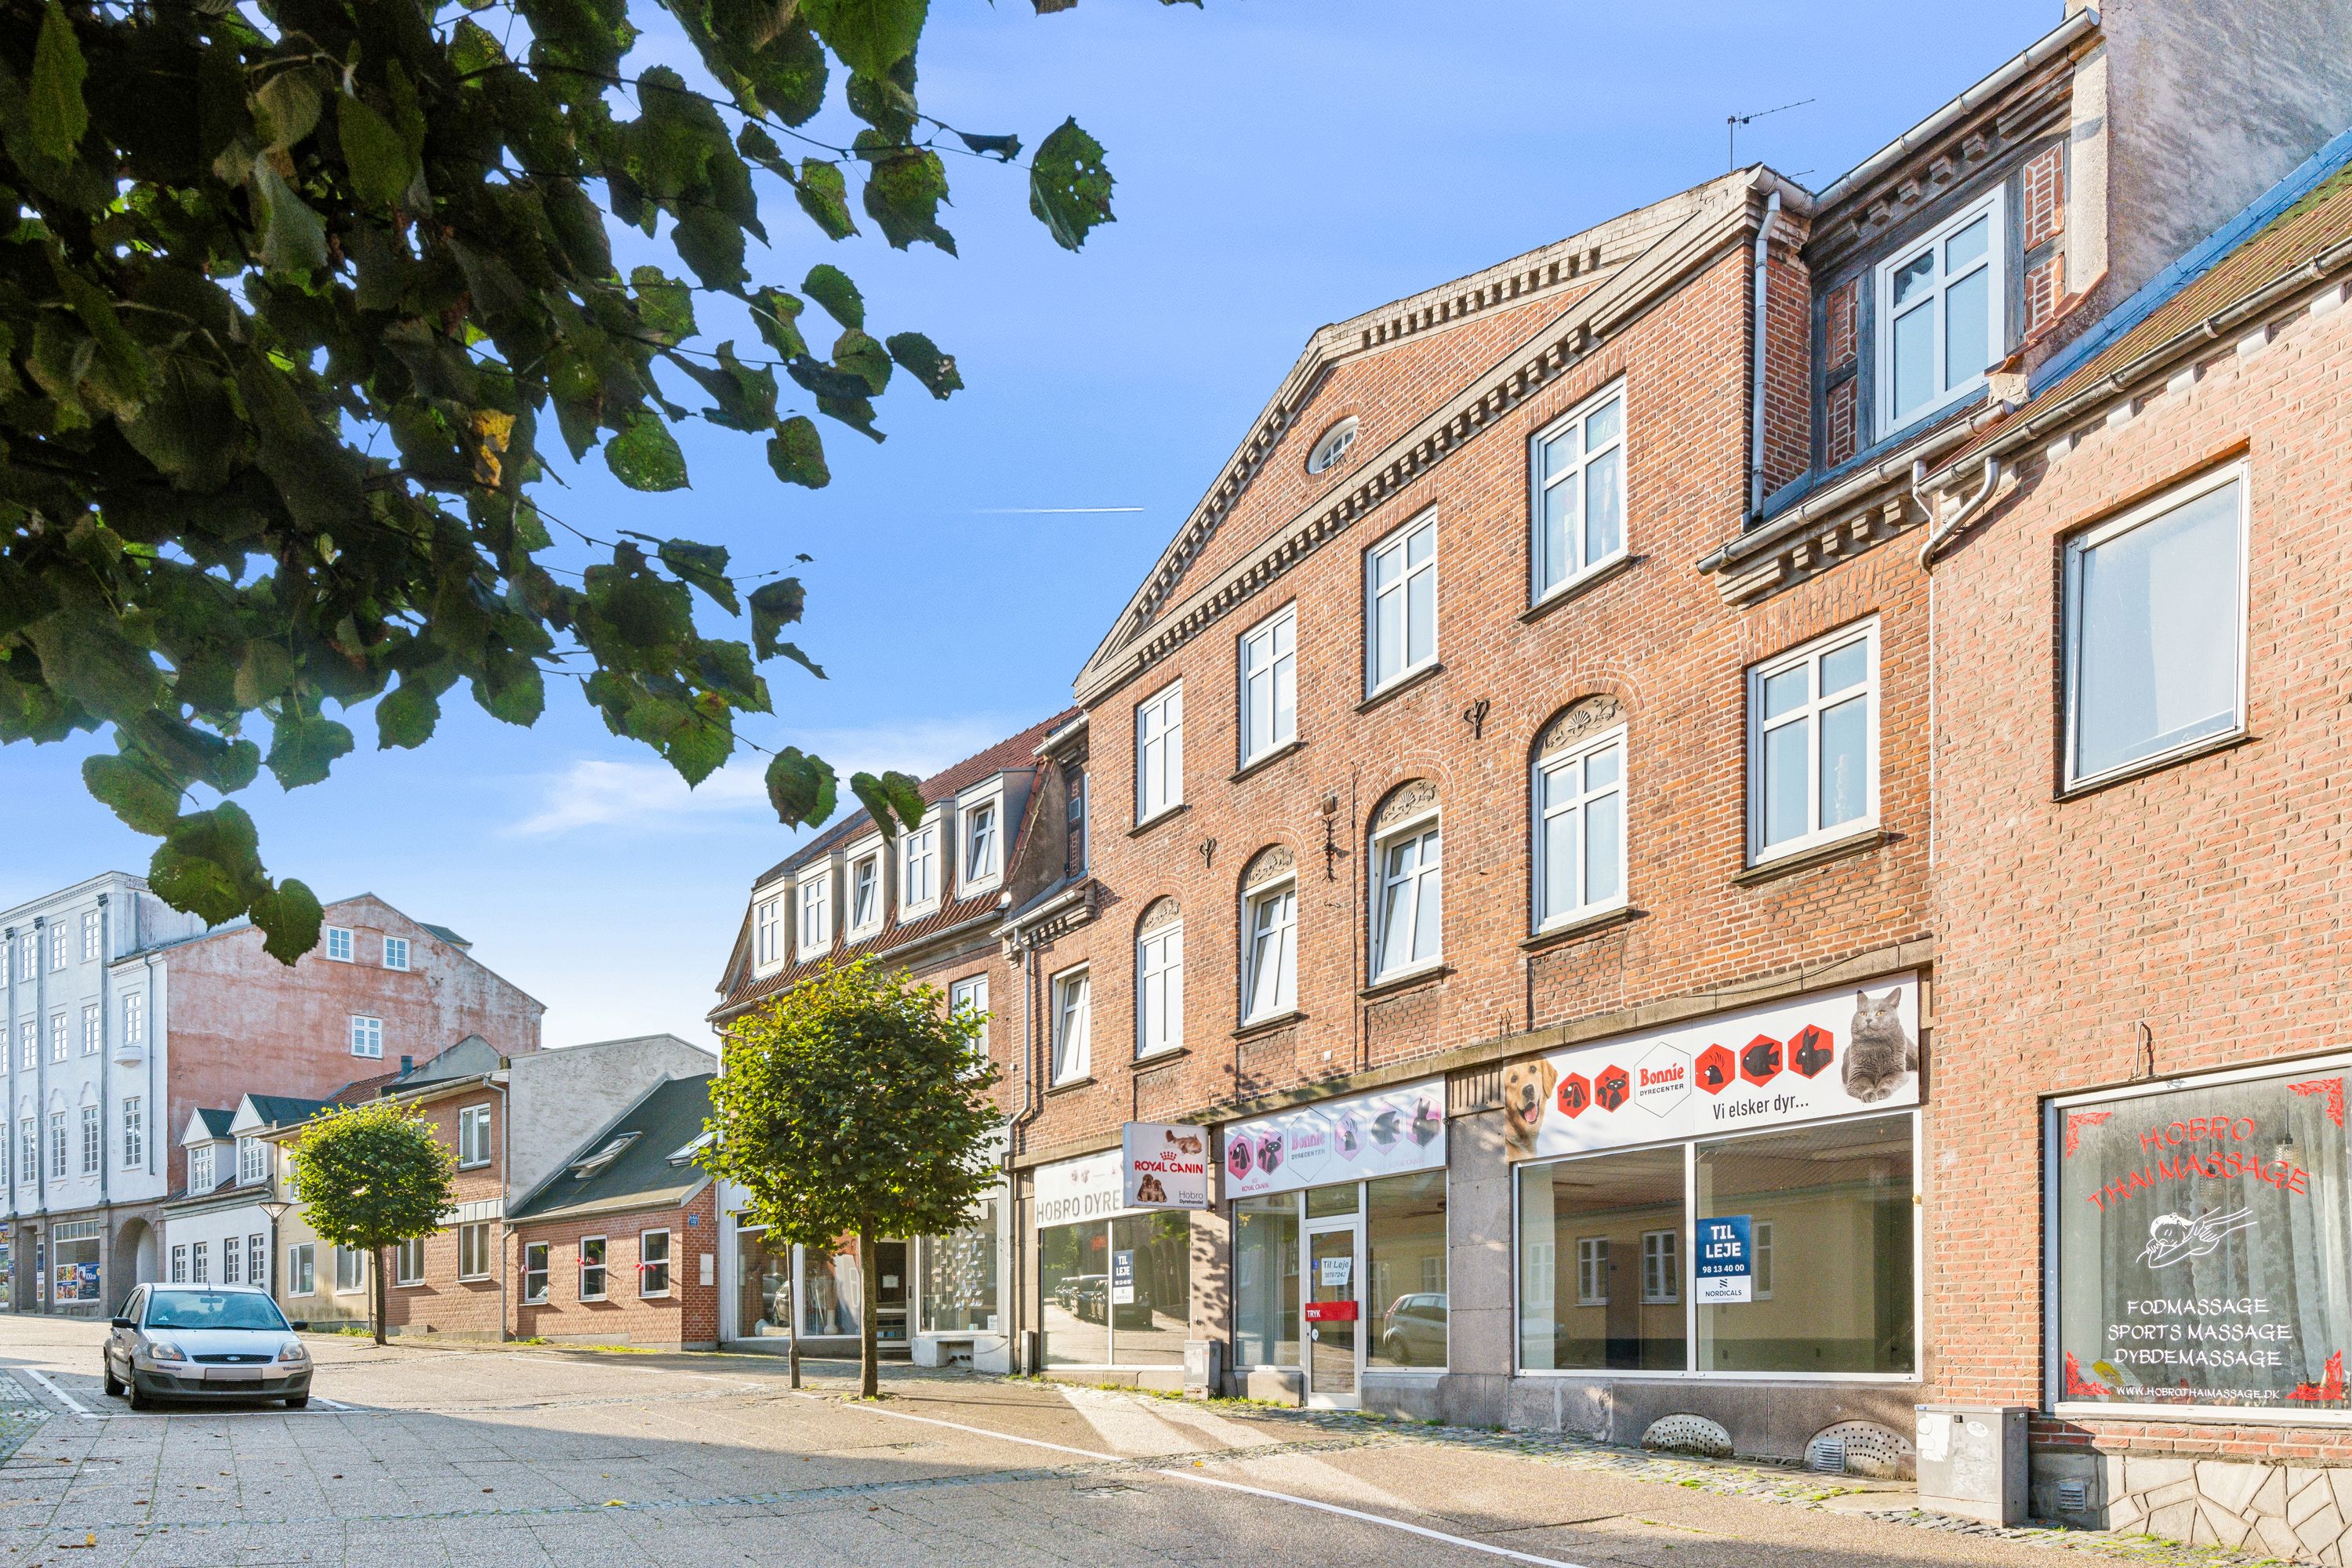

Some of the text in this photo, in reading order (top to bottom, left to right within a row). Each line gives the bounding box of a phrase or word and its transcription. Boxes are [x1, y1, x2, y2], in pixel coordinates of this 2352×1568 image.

[1639, 1062, 1685, 1087] Bonnie
[1639, 1083, 1685, 1097] DYRECENTER
[1713, 1094, 1809, 1120] Vi elsker dyr...
[1291, 1131, 1326, 1152] Bonnie
[2140, 1116, 2255, 1154] HOBRO
[1291, 1148, 1326, 1160] DYRECENTER
[1134, 1160, 1203, 1174] ROYAL CANIN
[1179, 1191, 1203, 1200] Hobro
[1036, 1196, 1080, 1224] HOBRO
[1711, 1225, 1735, 1240] TIL
[1706, 1243, 1741, 1258] LEJE
[1118, 1255, 1128, 1265] TIL
[1334, 1261, 1348, 1270] Leje
[1116, 1266, 1130, 1276] LEJE
[2127, 1298, 2270, 1316] FODMASSAGE
[2108, 1323, 2293, 1341] SPORTS MASSAGE
[2114, 1348, 2283, 1368] DYBDEMASSAGE
[2117, 1386, 2281, 1399] WWW.HOBROTHAIMASSAGE.DK
